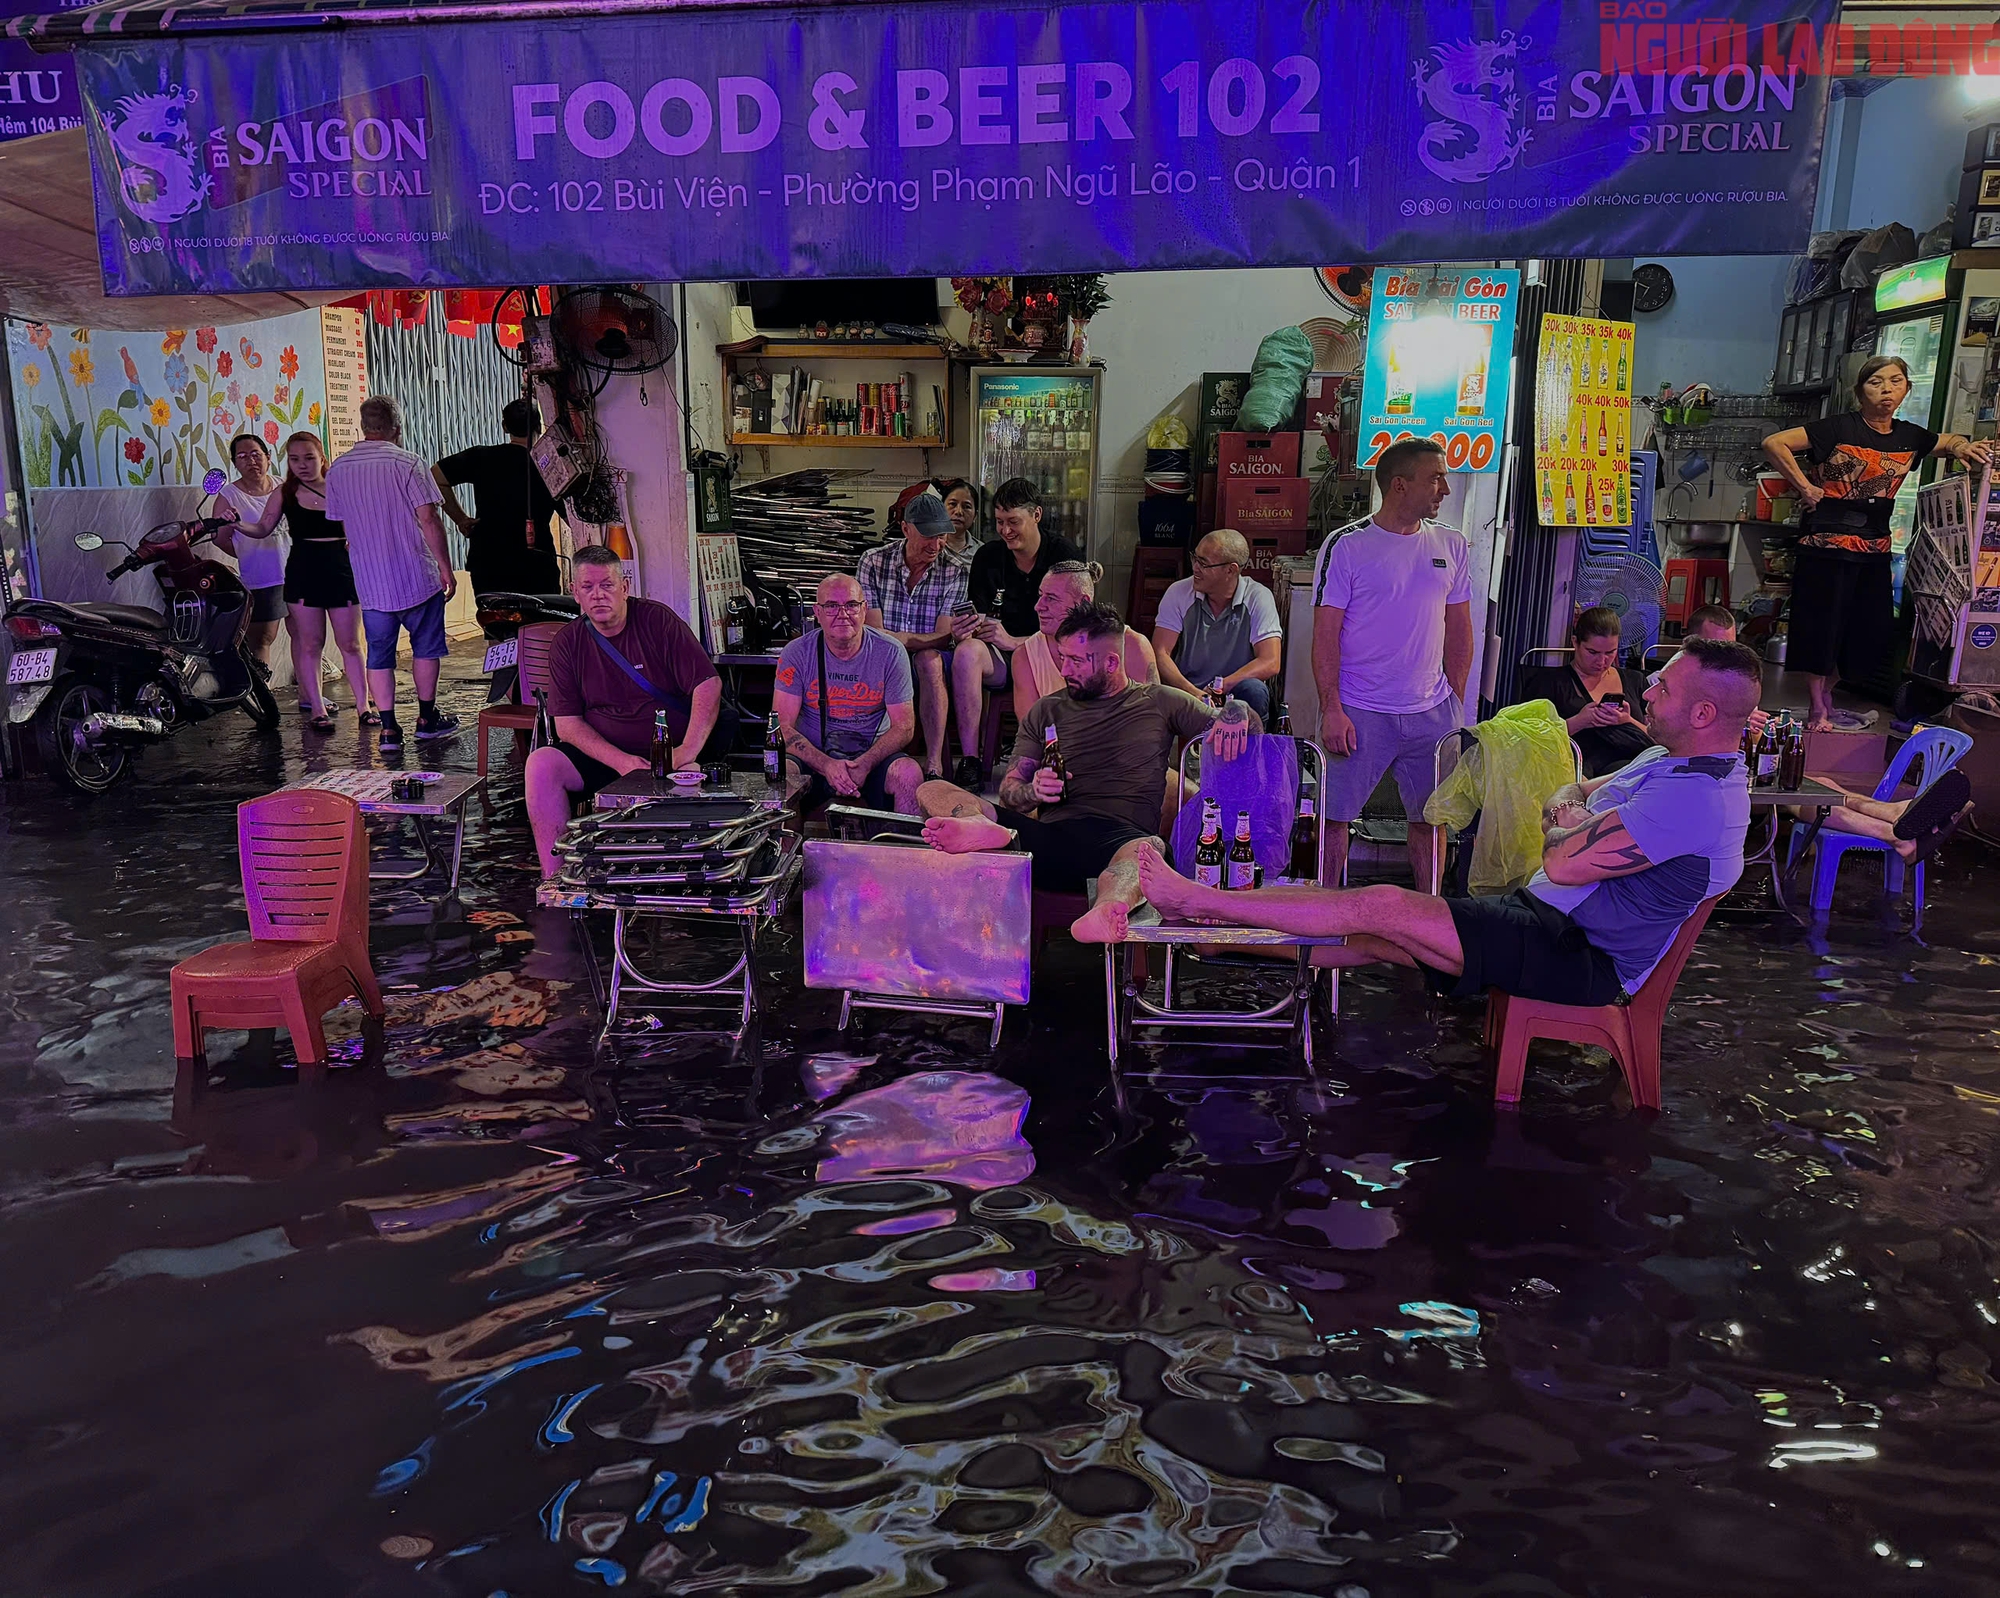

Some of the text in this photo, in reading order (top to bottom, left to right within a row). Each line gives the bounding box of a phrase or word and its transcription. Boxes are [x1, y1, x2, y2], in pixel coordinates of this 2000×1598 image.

[1536, 74, 1556, 122] BIA
[1569, 63, 1799, 120] SAIGON
[512, 55, 1321, 160] FOOD & BEER 102
[30, 117, 56, 134] 104
[238, 116, 429, 166] SAIGON
[1628, 121, 1791, 154] SPECIAL
[212, 125, 228, 168] BIA
[288, 169, 432, 199] SPECIAL
[478, 183, 540, 214] ĐC:
[548, 181, 604, 212] 102
[615, 176, 664, 211] Bùi
[674, 176, 748, 217] Viện
[783, 171, 920, 212] Phường
[932, 167, 1033, 211] Phạm
[1046, 163, 1118, 206] Ngũ
[1130, 162, 1197, 195] Lão
[1233, 157, 1336, 200] Quận
[1347, 155, 1360, 188] 1
[1545, 198, 1557, 207] 18
[1593, 193, 1640, 206] KHÔNG
[1643, 192, 1682, 206] ĐƯỢC
[1727, 191, 1764, 204] RƯỢU
[243, 236, 253, 246] 18
[281, 232, 321, 245] KHÔNG
[1385, 275, 1421, 297] Bia
[1464, 276, 1508, 298] Gòn
[1460, 304, 1500, 320] BEER
[1545, 318, 1632, 341] 30k 30k 35k 35k 40k
[329, 371, 351, 380] COLOR BLACK
[984, 382, 1020, 391] Panasonic
[1576, 393, 1592, 406] 40k
[1595, 395, 1611, 407] 40k
[1614, 396, 1630, 408] 50k
[1402, 416, 1426, 425] Green
[1248, 454, 1264, 463] BIA
[1560, 457, 1578, 471] 20k
[1580, 458, 1597, 471] 20k
[1612, 459, 1629, 472] 30k
[1229, 462, 1282, 475] SAIGON
[1598, 478, 1615, 491] 25k
[1256, 550, 1273, 558] BIA
[16, 651, 48, 667] 60-B4
[488, 653, 513, 670] 7794
[9, 665, 51, 682] 587.48
[828, 671, 859, 682] VINTAGE
